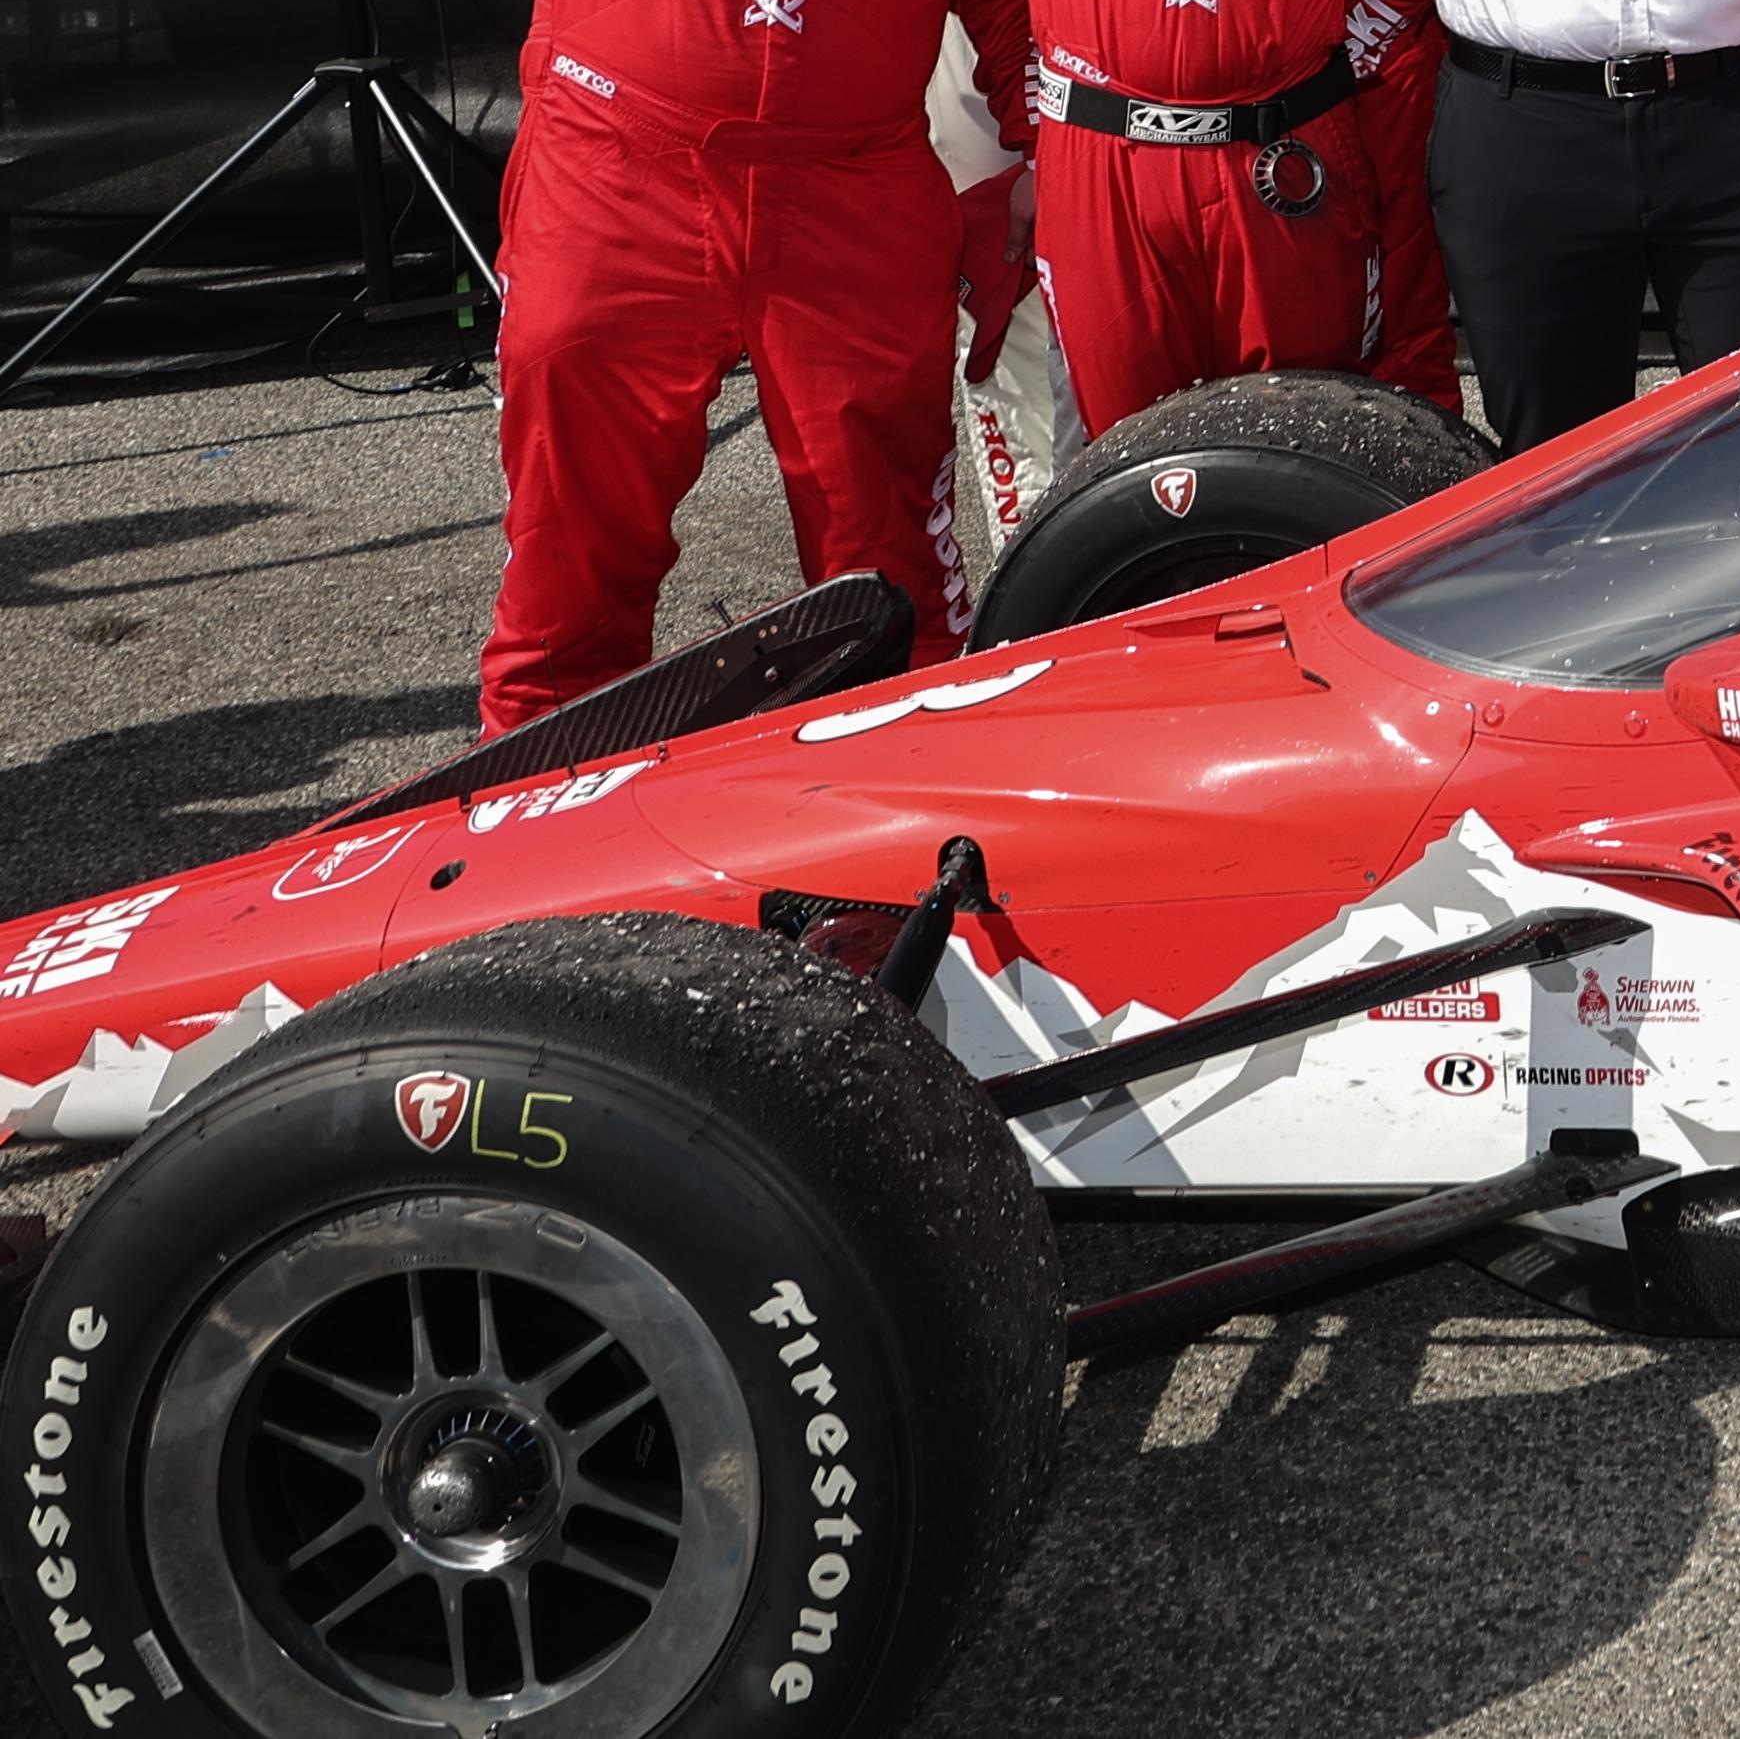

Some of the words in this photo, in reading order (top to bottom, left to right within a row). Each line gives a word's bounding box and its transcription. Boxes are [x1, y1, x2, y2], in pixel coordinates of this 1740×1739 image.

[553, 55, 616, 98] sparco
[1130, 125, 1193, 141] MECHANIX
[1194, 127, 1228, 143] WEAR
[1615, 976, 1695, 995] SHERWIN
[1380, 1000, 1486, 1020] WELDERS
[1617, 1015, 1666, 1024] Automotive
[1667, 1014, 1700, 1023] Finishes
[1441, 1059, 1476, 1088] R
[1515, 1067, 1581, 1086] RACING
[1585, 1067, 1647, 1086] OPTICS
[470, 1077, 575, 1171] L5
[746, 1277, 863, 1706] Firestone
[22, 1303, 138, 1732] Firestone
